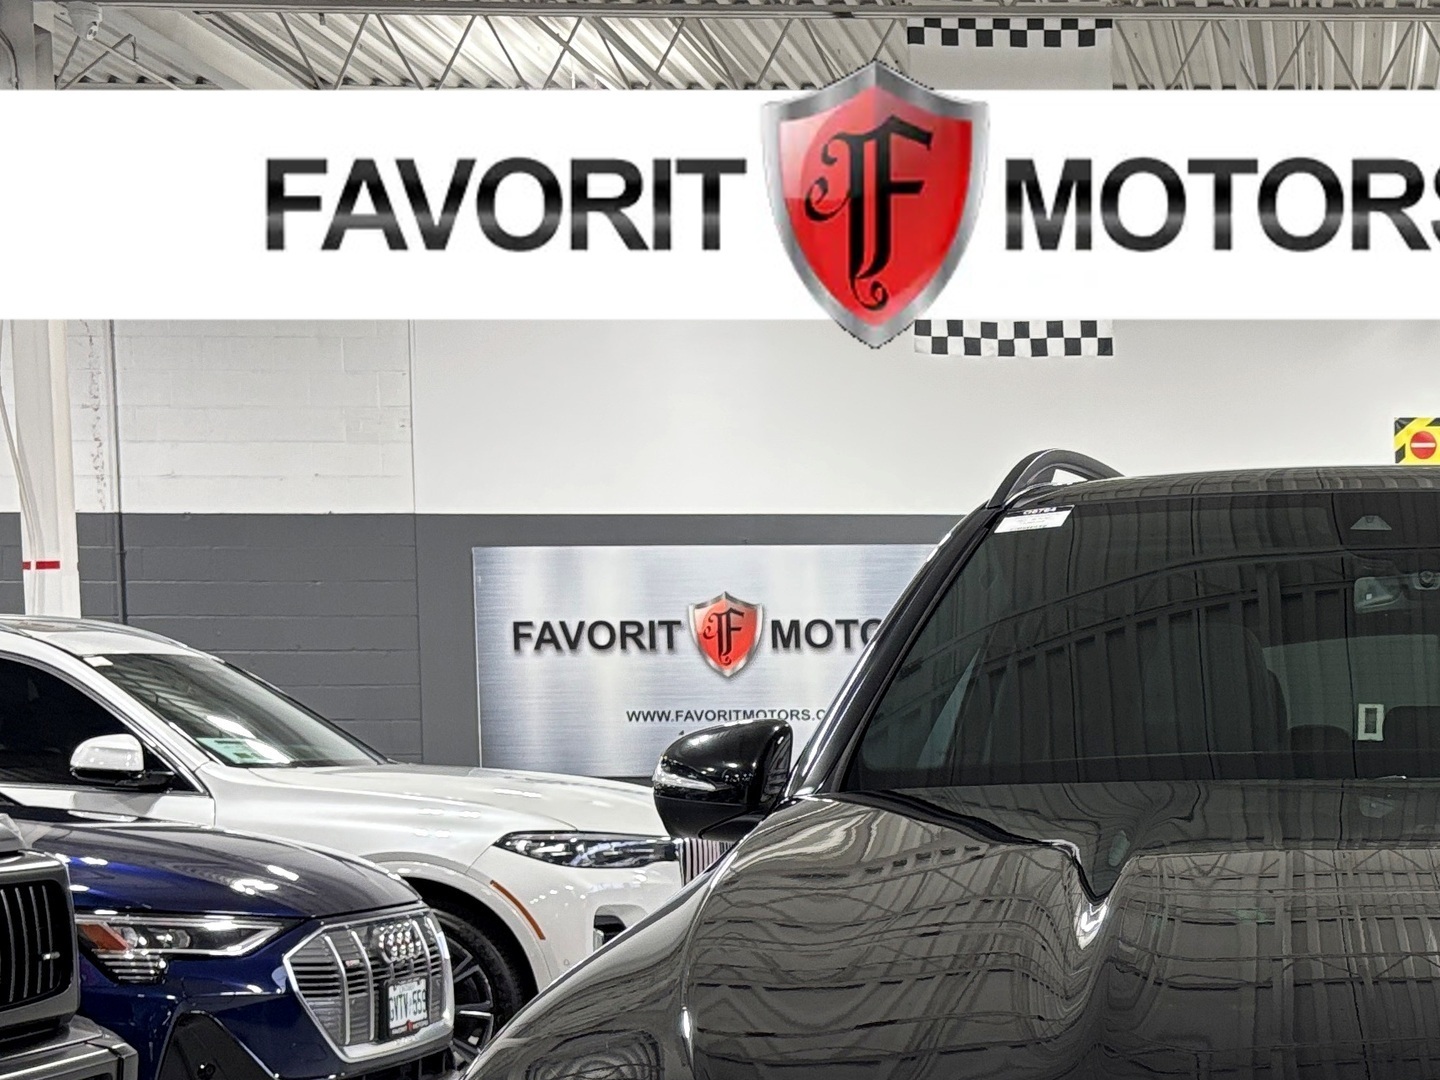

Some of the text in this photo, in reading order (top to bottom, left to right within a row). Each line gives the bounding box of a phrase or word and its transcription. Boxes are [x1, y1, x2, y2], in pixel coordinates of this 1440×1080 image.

[512, 619, 682, 651] FAVORIT
[771, 618, 882, 649] MOTO
[626, 708, 826, 723] WWW.FAVORITMOTORS.C
